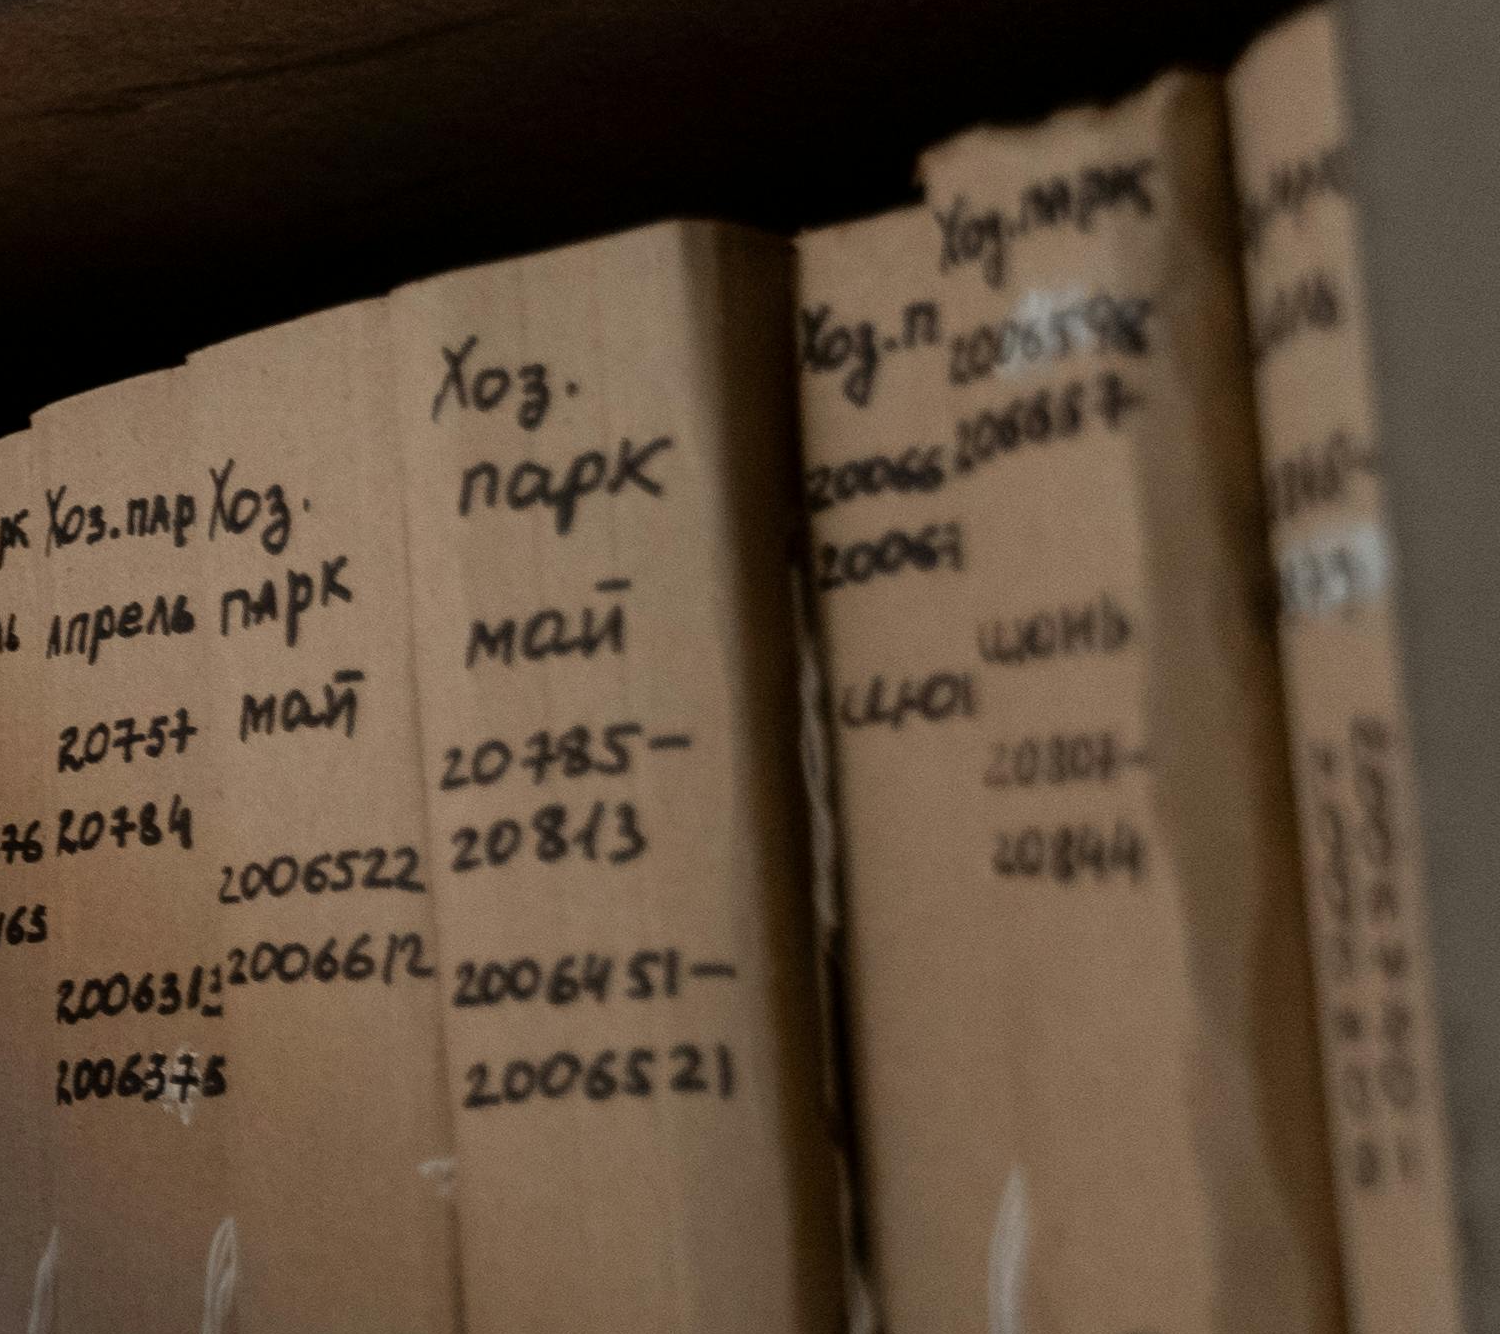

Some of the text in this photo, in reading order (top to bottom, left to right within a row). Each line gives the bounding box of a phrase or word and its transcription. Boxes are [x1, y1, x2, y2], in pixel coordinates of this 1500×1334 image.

[465, 577, 632, 669] май
[57, 707, 198, 773] 20757
[56, 794, 194, 857] 20784
[450, 800, 648, 873] 20813
[218, 845, 426, 904] 2006522
[226, 932, 434, 987] 2006612
[463, 1041, 735, 1111] 2006521
